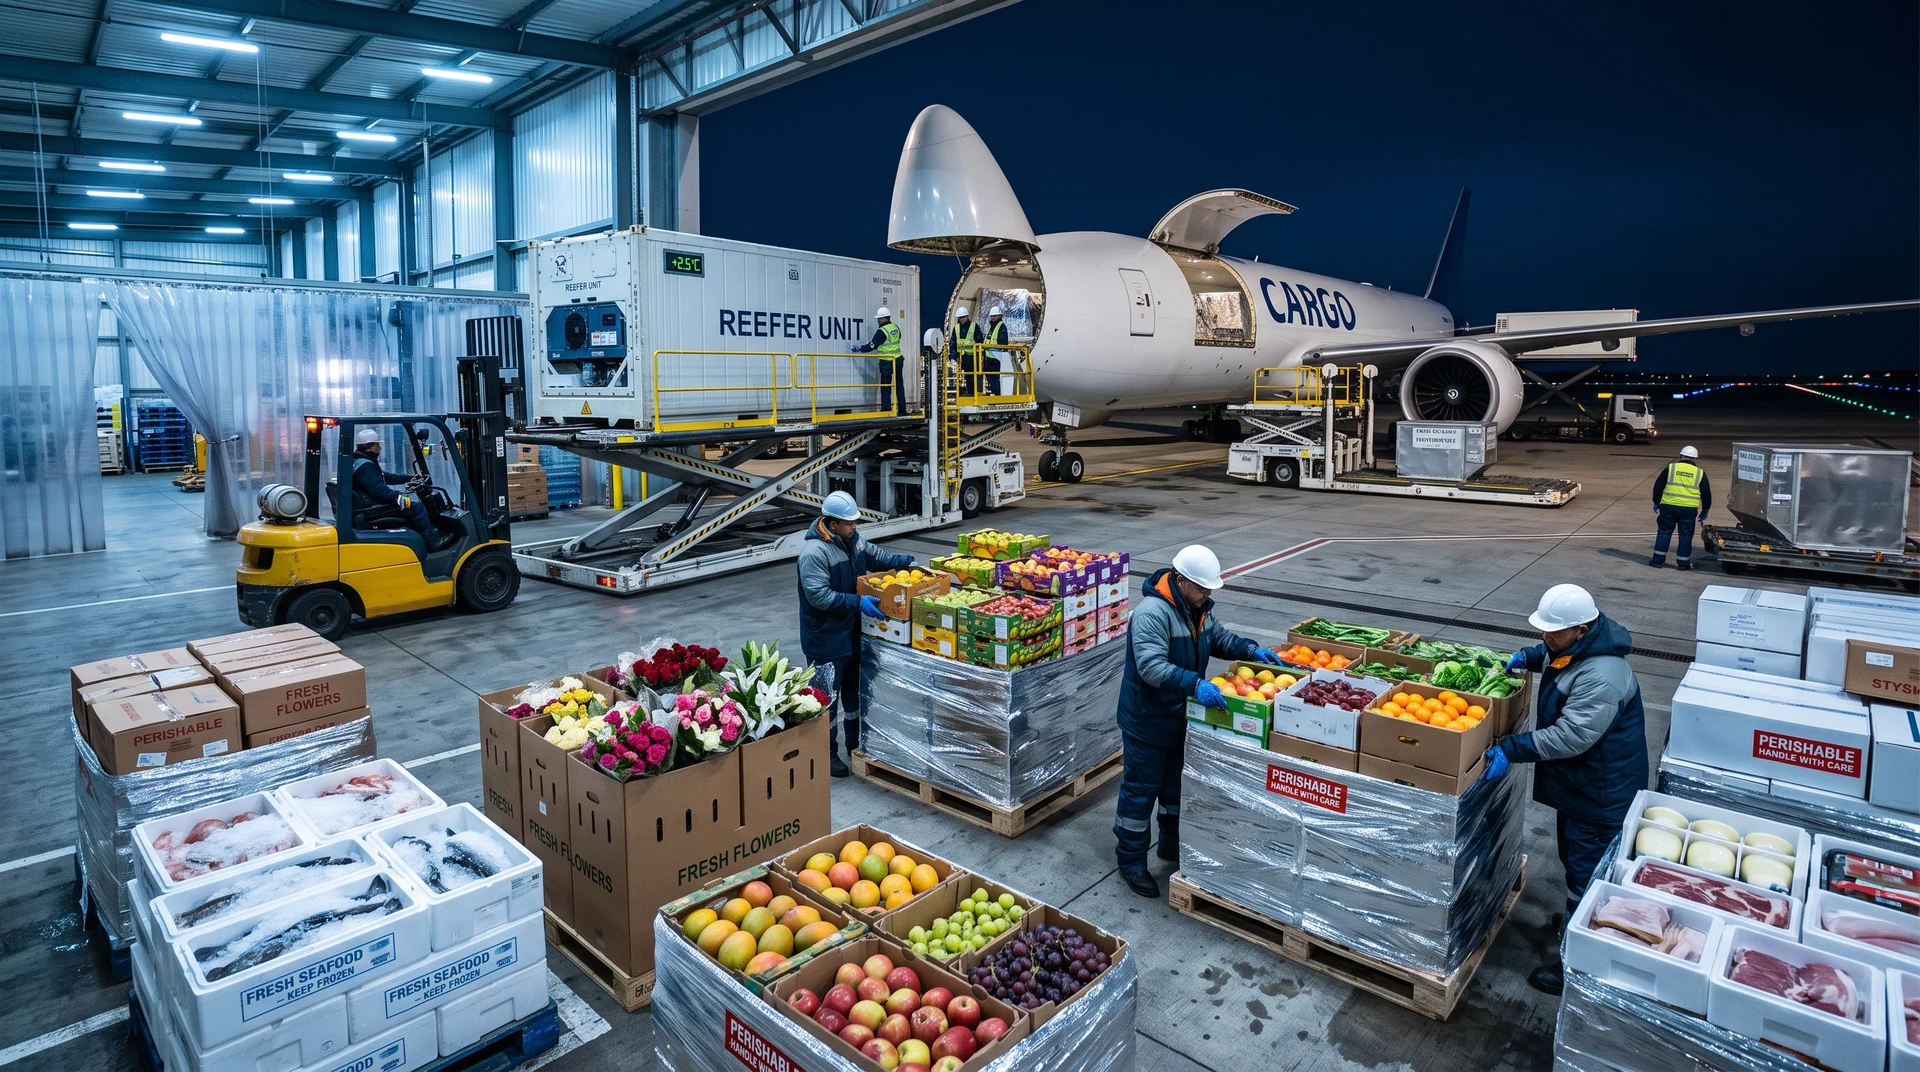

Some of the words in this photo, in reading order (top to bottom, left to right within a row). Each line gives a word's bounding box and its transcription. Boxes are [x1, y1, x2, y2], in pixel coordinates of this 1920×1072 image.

[565, 282, 588, 292] REEFER
[588, 280, 602, 290] UNIT
[1259, 276, 1357, 331] CARGO
[719, 309, 812, 339] REEFER
[819, 315, 864, 341] UNIT
[276, 692, 341, 717] FLOWERS
[286, 682, 330, 701] FRESH
[133, 718, 223, 747] PERISHABLE
[1758, 747, 1797, 762] HANDLE
[1799, 755, 1825, 768] WITH
[1827, 760, 1854, 773] CARE
[1759, 734, 1855, 763] PERISHABLE
[1270, 781, 1299, 797] HANDLE
[1300, 789, 1319, 802] WITH
[1319, 796, 1340, 808] CARE
[1272, 768, 1342, 799] PERISHABLE
[489, 788, 514, 819] FRESH
[529, 818, 558, 853] FRESH
[560, 840, 613, 894] FLOWERS
[677, 853, 729, 886] FRESH
[734, 818, 801, 863] FLOWERS
[246, 976, 295, 1005] FRESH
[298, 949, 363, 984] SEAFOOD
[287, 983, 314, 1001] KEEP
[389, 977, 430, 1003] FRESH
[433, 952, 490, 984] SEAFOOD
[423, 983, 446, 1000] KEEP
[449, 968, 481, 989] FROZEN
[730, 1018, 800, 1072] PERISHABL
[730, 1037, 758, 1069] HANDLE
